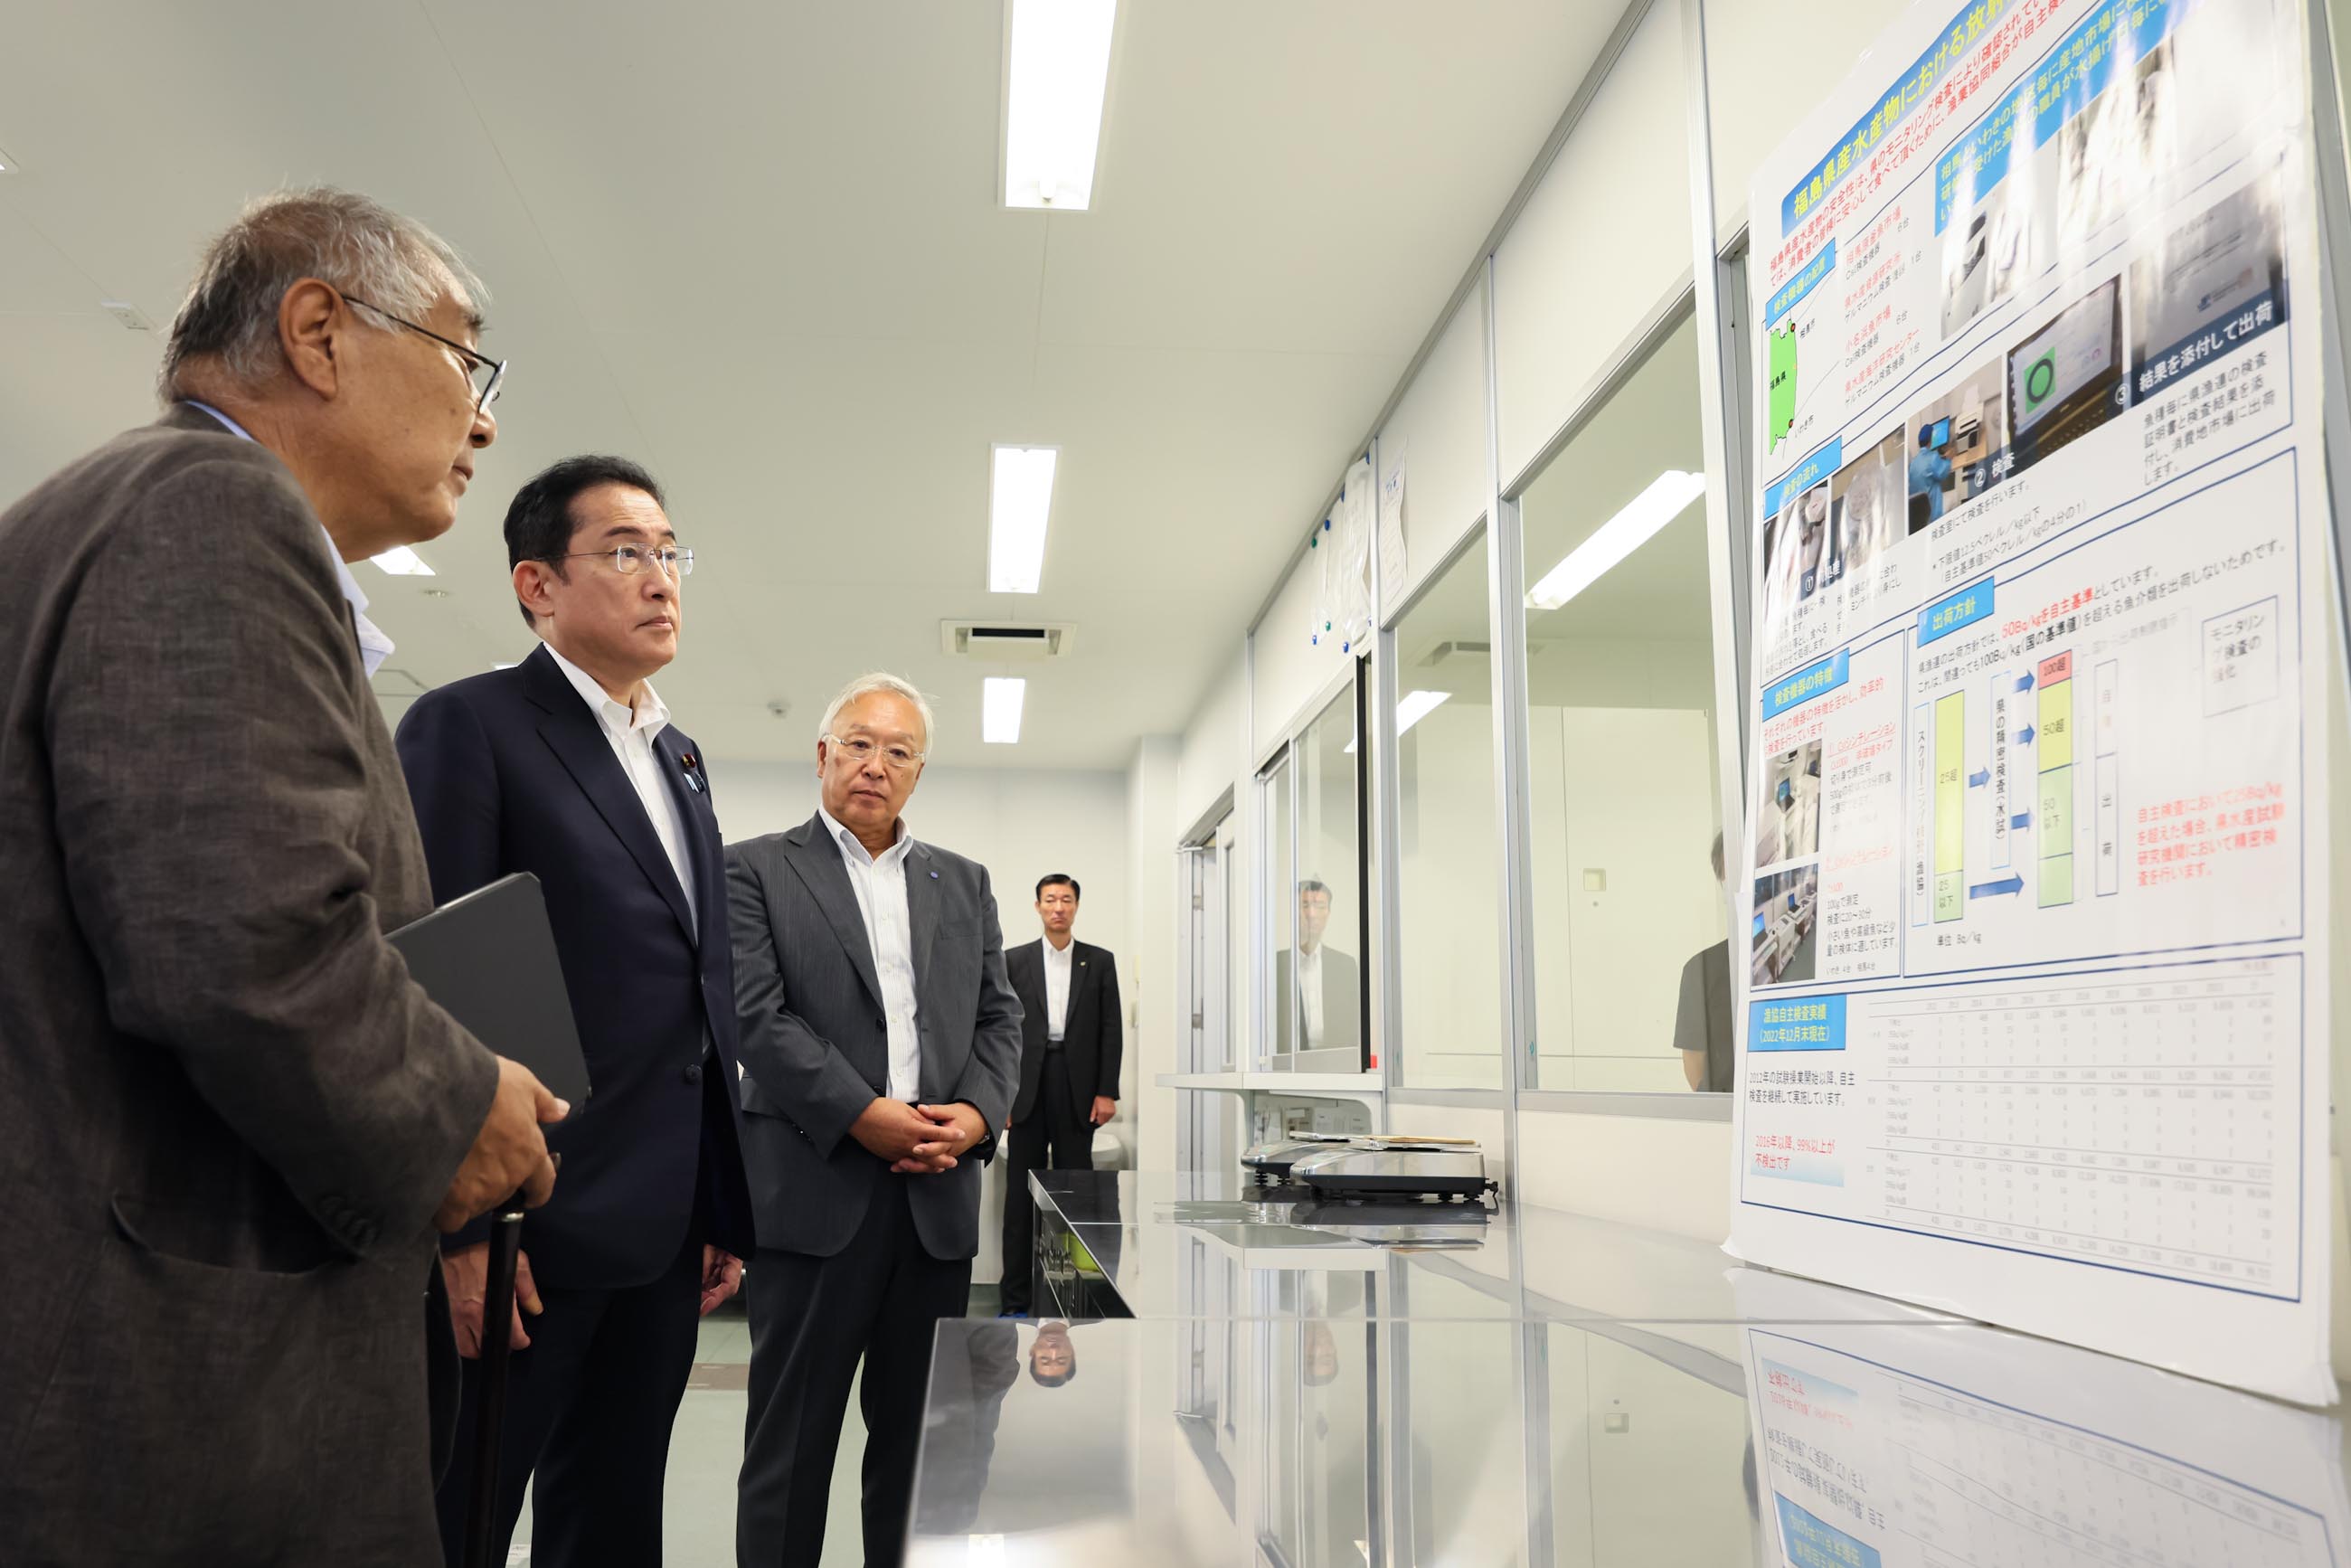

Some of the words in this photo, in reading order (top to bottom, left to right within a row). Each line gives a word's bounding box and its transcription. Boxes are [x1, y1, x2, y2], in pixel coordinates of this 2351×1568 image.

[1793, 0, 2011, 220] 福島県産水産物における放射
[1770, 0, 2065, 287] ては、消費者の皆様に安心して食べて頂くために、漁業協同組合が自主検
[2139, 299, 2273, 392] 結果を添付して出荷
[1991, 451, 2015, 477] 検査
[1931, 592, 1978, 632] 出荷方針
[1749, 1089, 1846, 1107] 検査を継続して実施しています。
[1755, 1153, 1790, 1171] 不検出です
